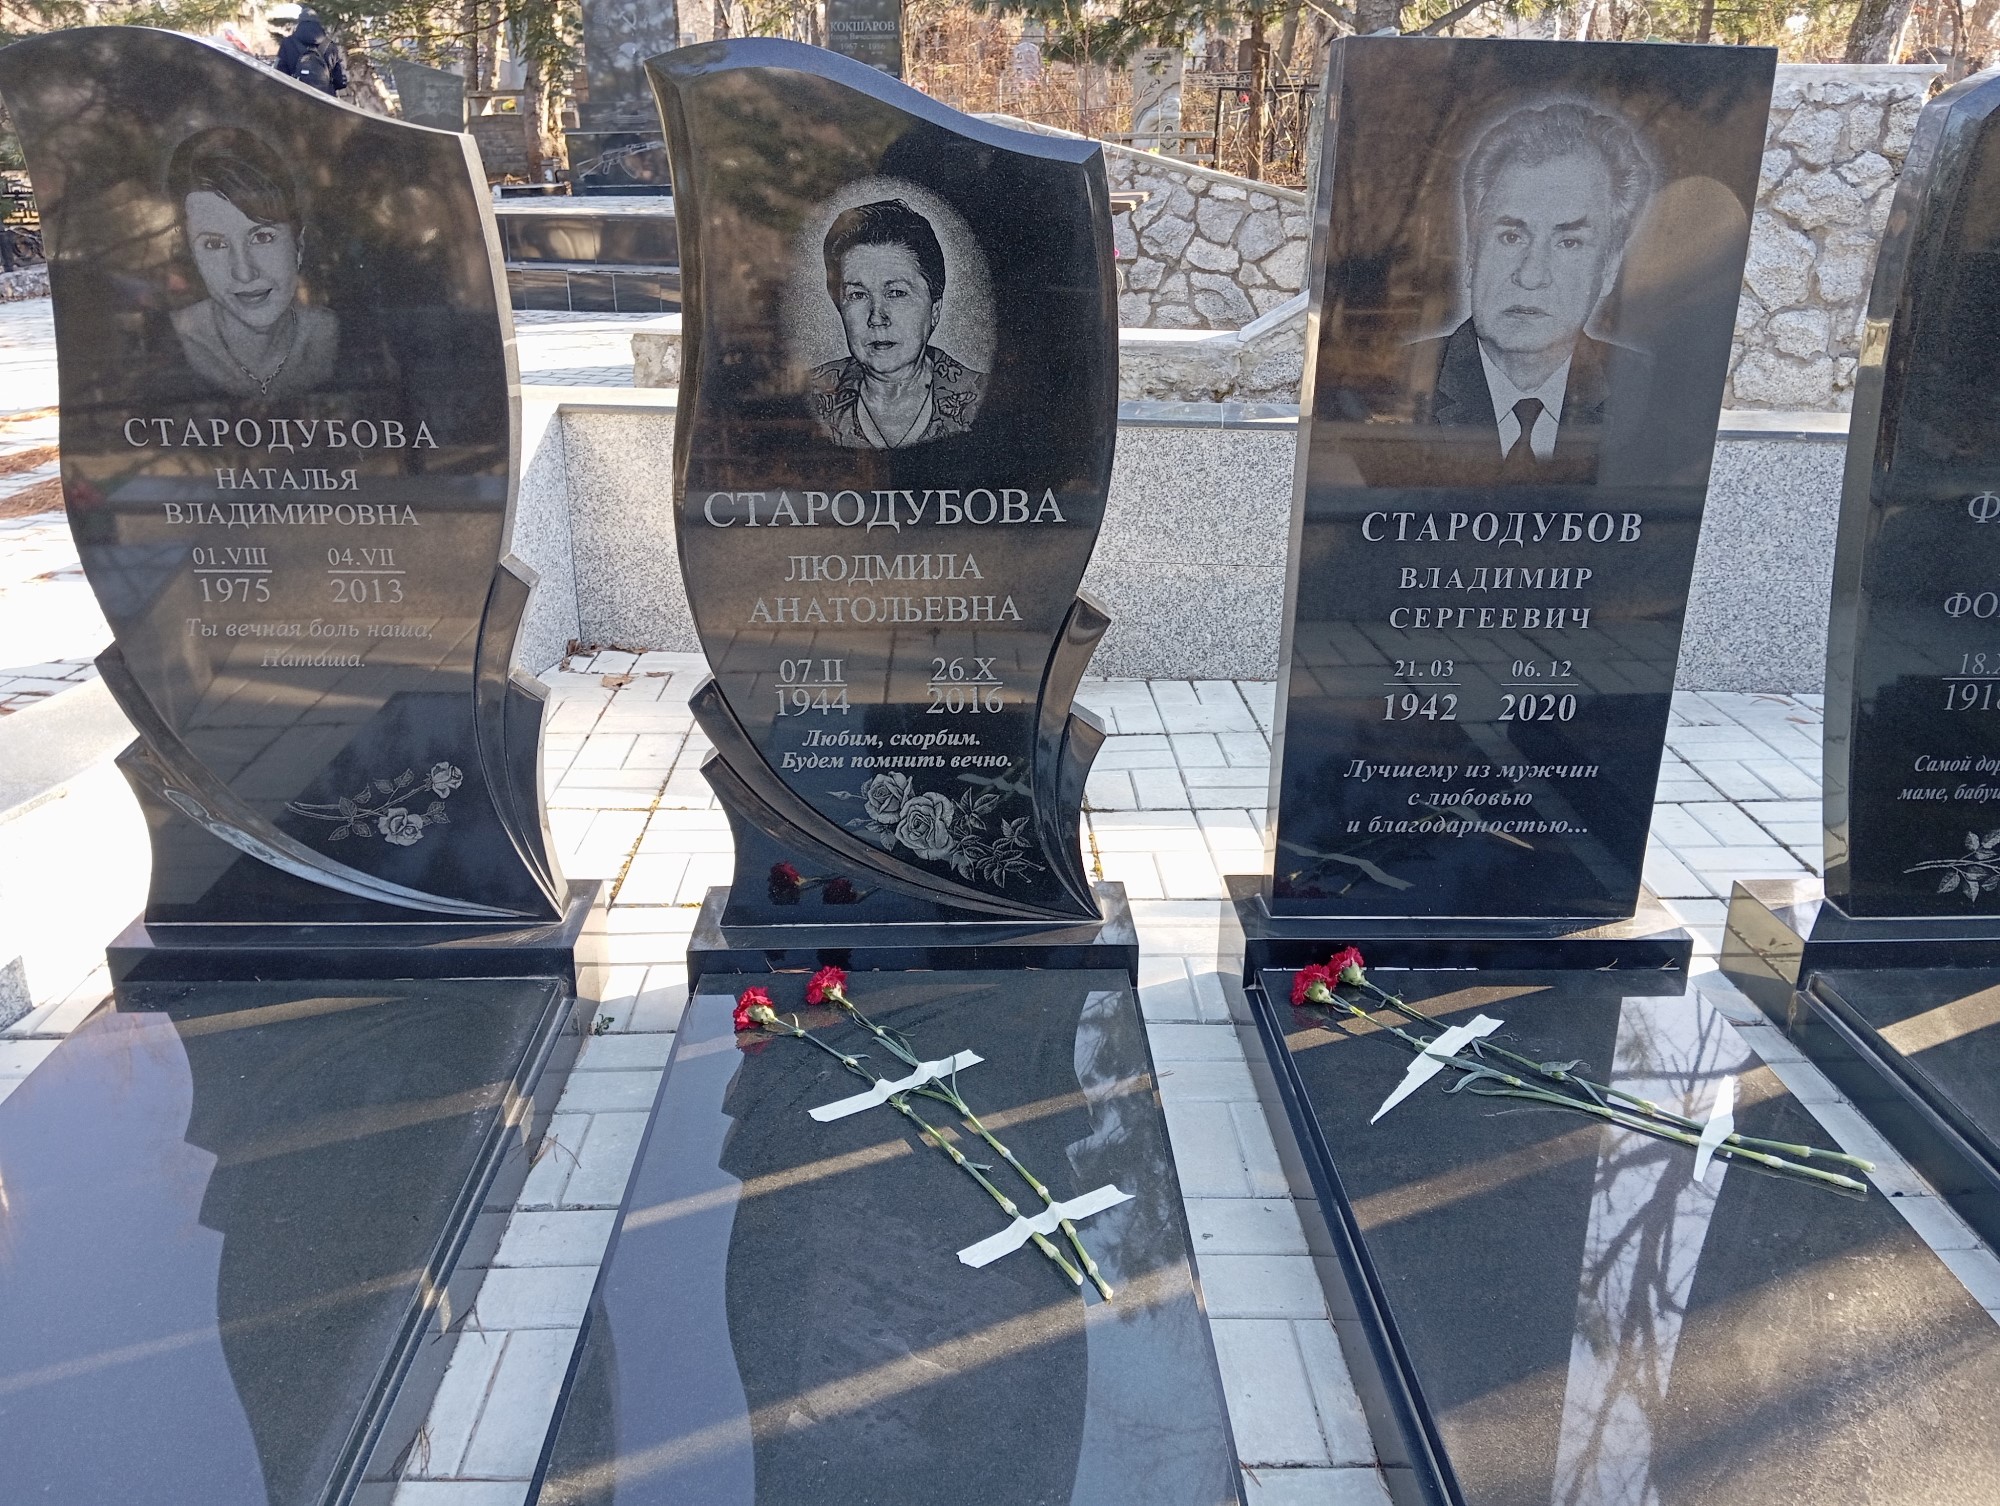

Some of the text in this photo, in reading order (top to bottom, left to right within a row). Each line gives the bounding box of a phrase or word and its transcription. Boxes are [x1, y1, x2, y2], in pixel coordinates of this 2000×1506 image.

[830, 20, 895, 32] КОКШАРОВ
[123, 417, 440, 454] СТАРОДУБОВА
[215, 467, 360, 491] НАТАЛЬЯ
[164, 503, 420, 529] ВЛАДИМИРОВНА
[703, 487, 1067, 534] СТАРОДУБОВА
[1967, 490, 2000, 524] Ф
[1361, 510, 1643, 549] СТАРОДУБОВ
[193, 547, 269, 566] 01.VIII
[327, 547, 396, 566] 04.VII
[784, 553, 985, 587] ЛЮДМИЛА
[1398, 567, 1593, 593] ВЛАДИМИР
[200, 577, 272, 603] 1975
[330, 578, 405, 604] 2013
[747, 595, 1023, 624] АНАТОЛЬЕВНА
[1943, 591, 2000, 618] ФО
[186, 618, 433, 640] Ты вечная боль наша,
[1388, 606, 1592, 630] СЕРГЕЕВИЧ
[260, 649, 366, 668] Наташа.
[779, 658, 846, 683] 07.II
[776, 688, 851, 717] 1944
[926, 686, 1004, 715] 2016
[1382, 692, 1458, 721] 1942
[1497, 692, 1577, 722] 2020
[1943, 683, 2000, 711] 191
[802, 729, 981, 752] Любим, скорбим.
[781, 751, 1013, 772] Будем помнить вечно.
[1343, 759, 1600, 782] Лучшему из мужчин
[1914, 754, 1973, 772] Самой
[1407, 788, 1533, 806] с любовью
[1896, 788, 1949, 803] маме,
[1346, 815, 1589, 838] и благодарностью...
